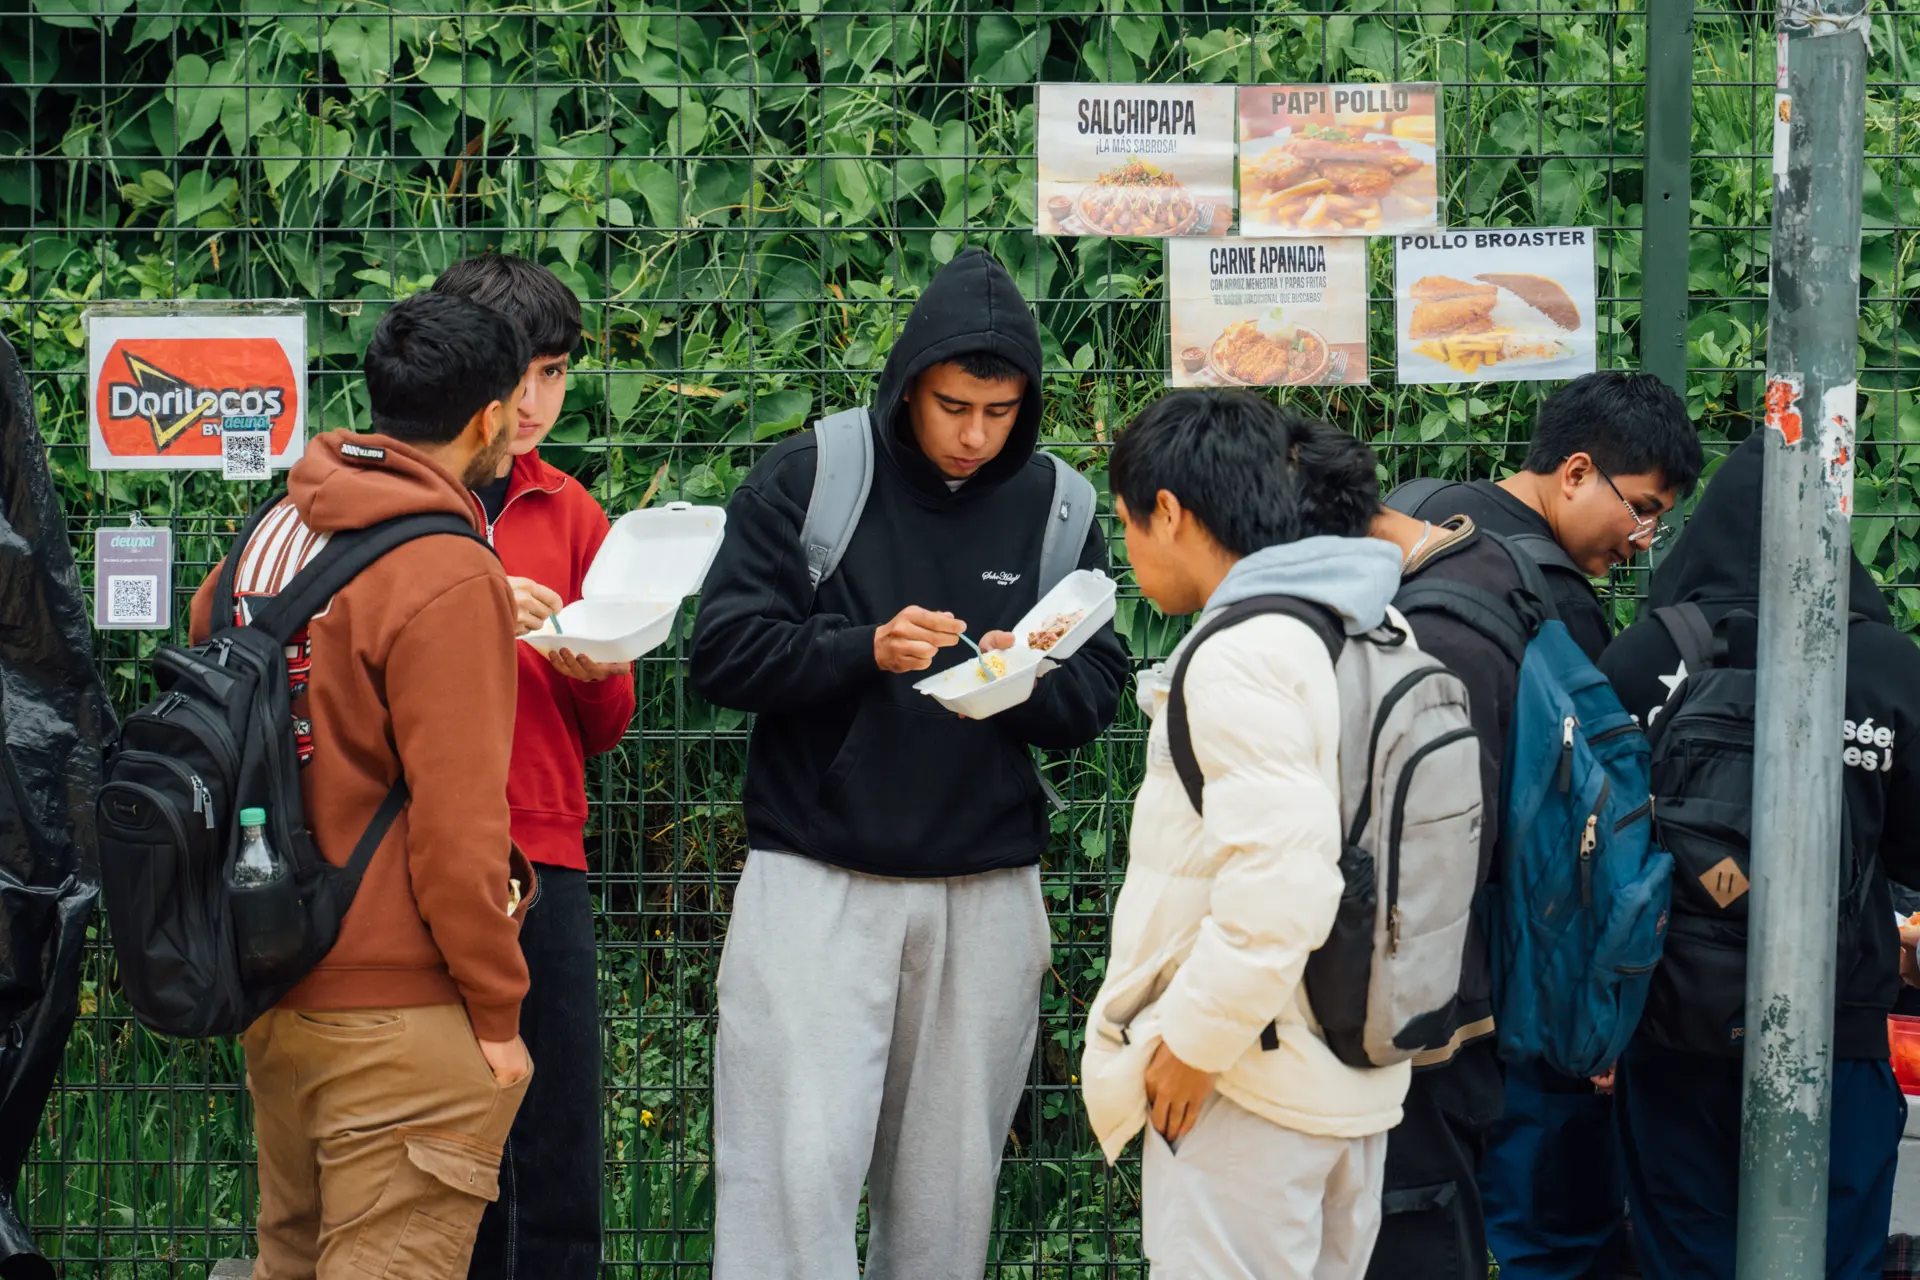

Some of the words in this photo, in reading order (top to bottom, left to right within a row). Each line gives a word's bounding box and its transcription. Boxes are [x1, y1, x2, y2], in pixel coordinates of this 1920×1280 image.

[1271, 91, 1326, 114] PAPI
[1334, 90, 1409, 113] POLLO
[1078, 98, 1196, 135] SALCHIPAPA
[1112, 136, 1132, 153] MÁS
[1133, 139, 1177, 153] SABROSA!
[1401, 234, 1468, 250] POLLO
[1475, 231, 1586, 248] BROASTER
[1210, 247, 1256, 275] CARNE
[1260, 245, 1326, 274] APANADA
[1210, 278, 1224, 291] CON
[1224, 278, 1245, 291] ARROZ
[1246, 277, 1278, 290] MENESTRA
[1280, 277, 1284, 289] Y
[1285, 277, 1305, 289] PAPAS
[1306, 276, 1327, 288] FRITAS
[1280, 292, 1291, 304] QUE
[111, 385, 281, 417] Dorilocos
[202, 424, 222, 436] BY
[110, 534, 155, 548] deuna!
